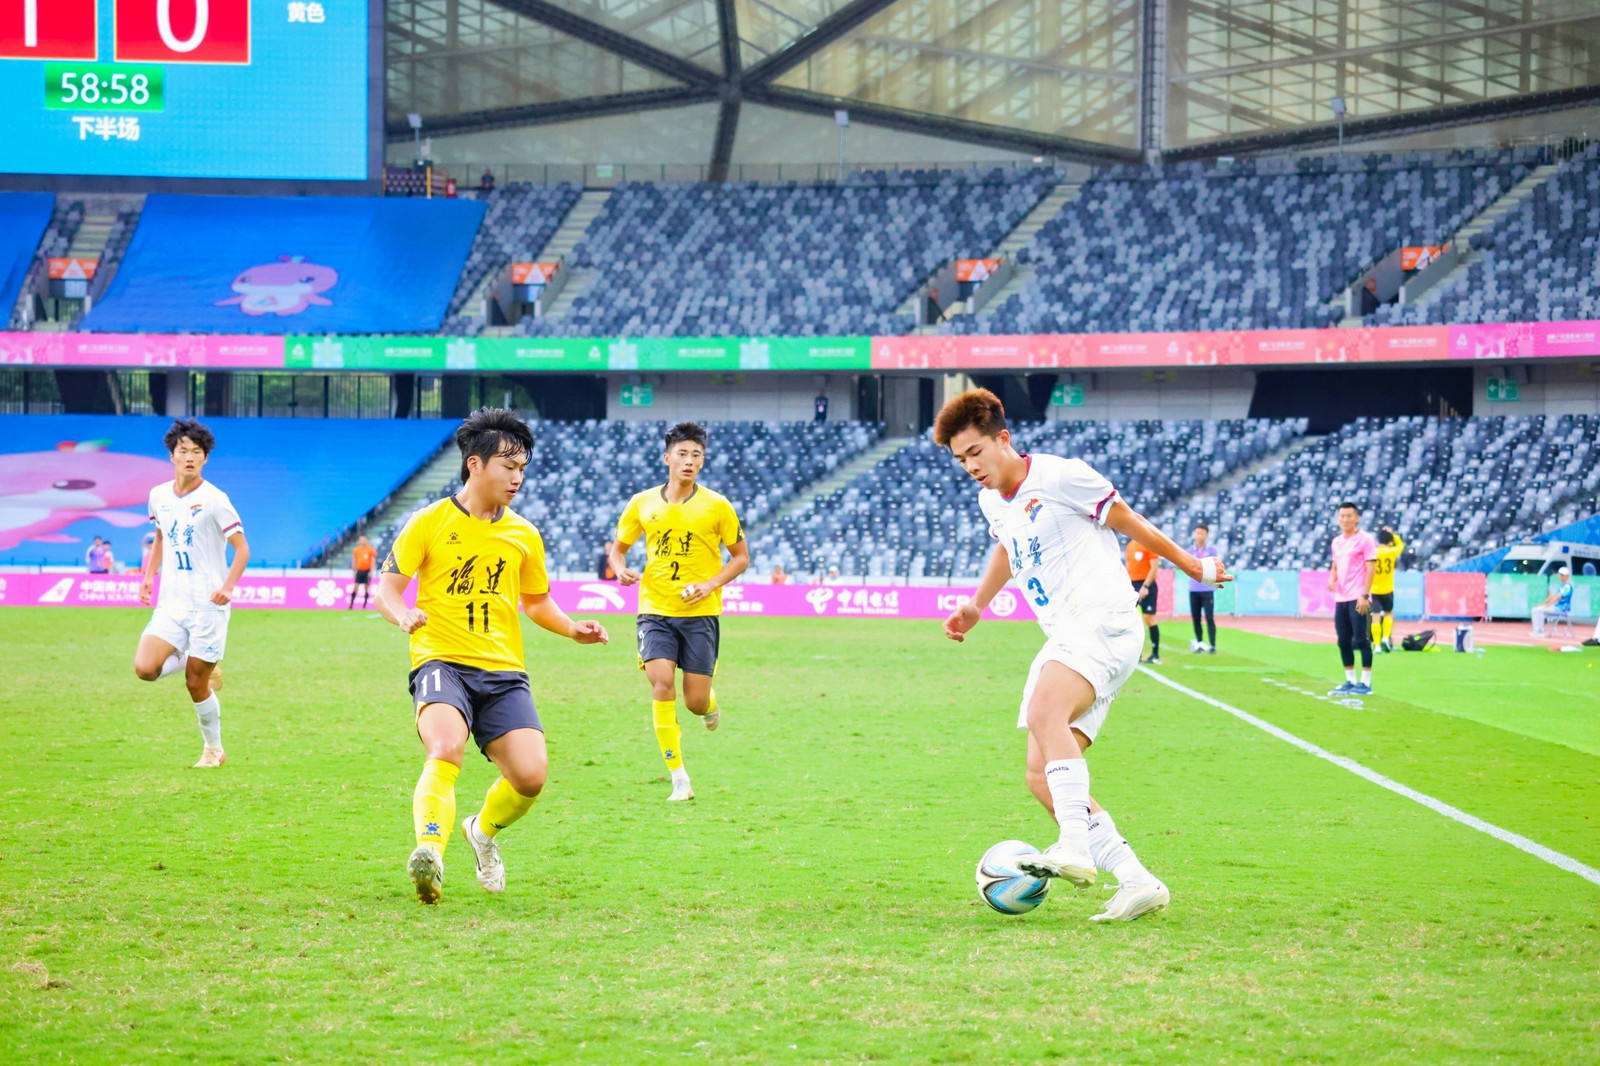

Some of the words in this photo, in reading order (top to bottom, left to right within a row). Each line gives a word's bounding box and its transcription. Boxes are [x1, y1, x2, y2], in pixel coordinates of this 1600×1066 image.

[287, 1, 326, 23] 黄色
[156, 0, 209, 52] 0
[61, 72, 150, 105] 58:58
[72, 116, 140, 140] 下半场
[176, 551, 192, 570] 11
[670, 561, 681, 581] 2
[1375, 558, 1392, 575] 33
[1027, 577, 1049, 607] 3
[466, 602, 489, 633] 11
[421, 669, 441, 697] 11
